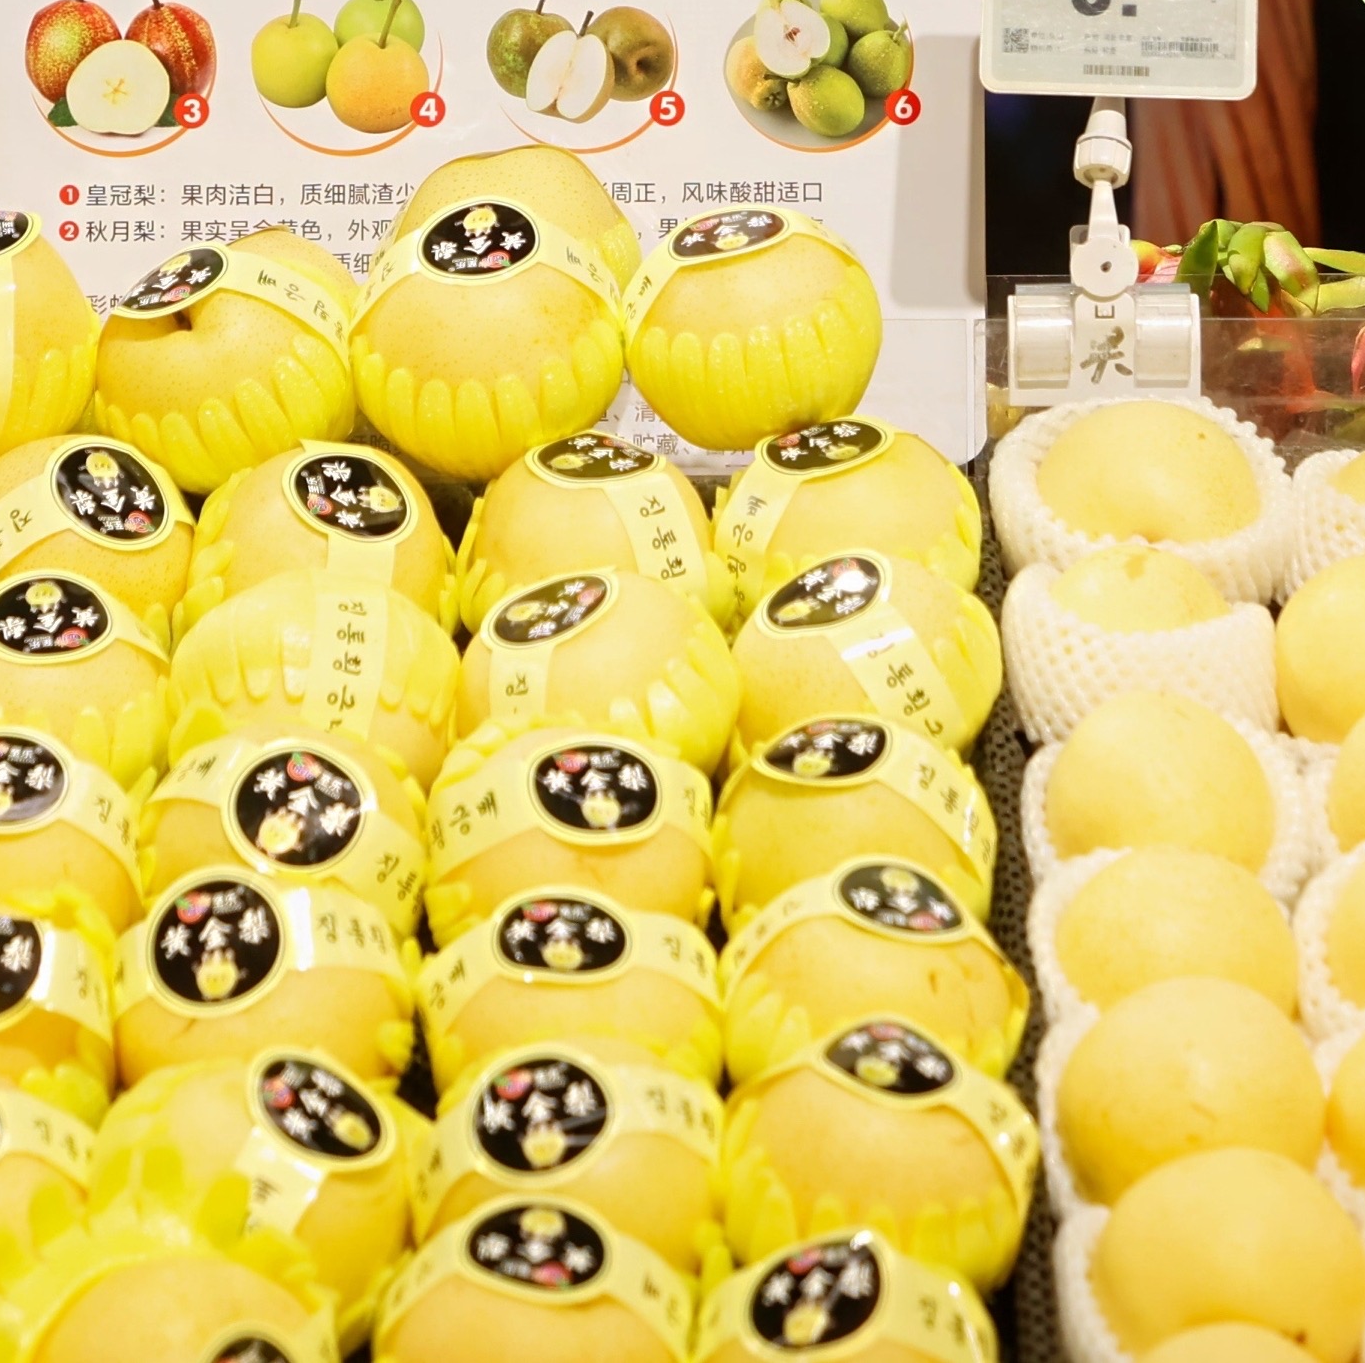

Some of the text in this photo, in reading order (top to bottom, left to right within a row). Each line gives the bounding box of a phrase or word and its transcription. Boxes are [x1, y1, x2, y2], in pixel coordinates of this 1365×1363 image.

[432, 231, 528, 263] 黄金梨
[682, 214, 773, 247] 黄金梨
[69, 483, 157, 515] 黄金梨
[322, 460, 367, 529] 黄金梨
[544, 762, 648, 794] 黄金梨
[254, 767, 357, 837] 黄金梨
[160, 907, 271, 960] 黄金梨
[507, 915, 617, 944] 黄金梨
[480, 1077, 597, 1134] 黄金梨
